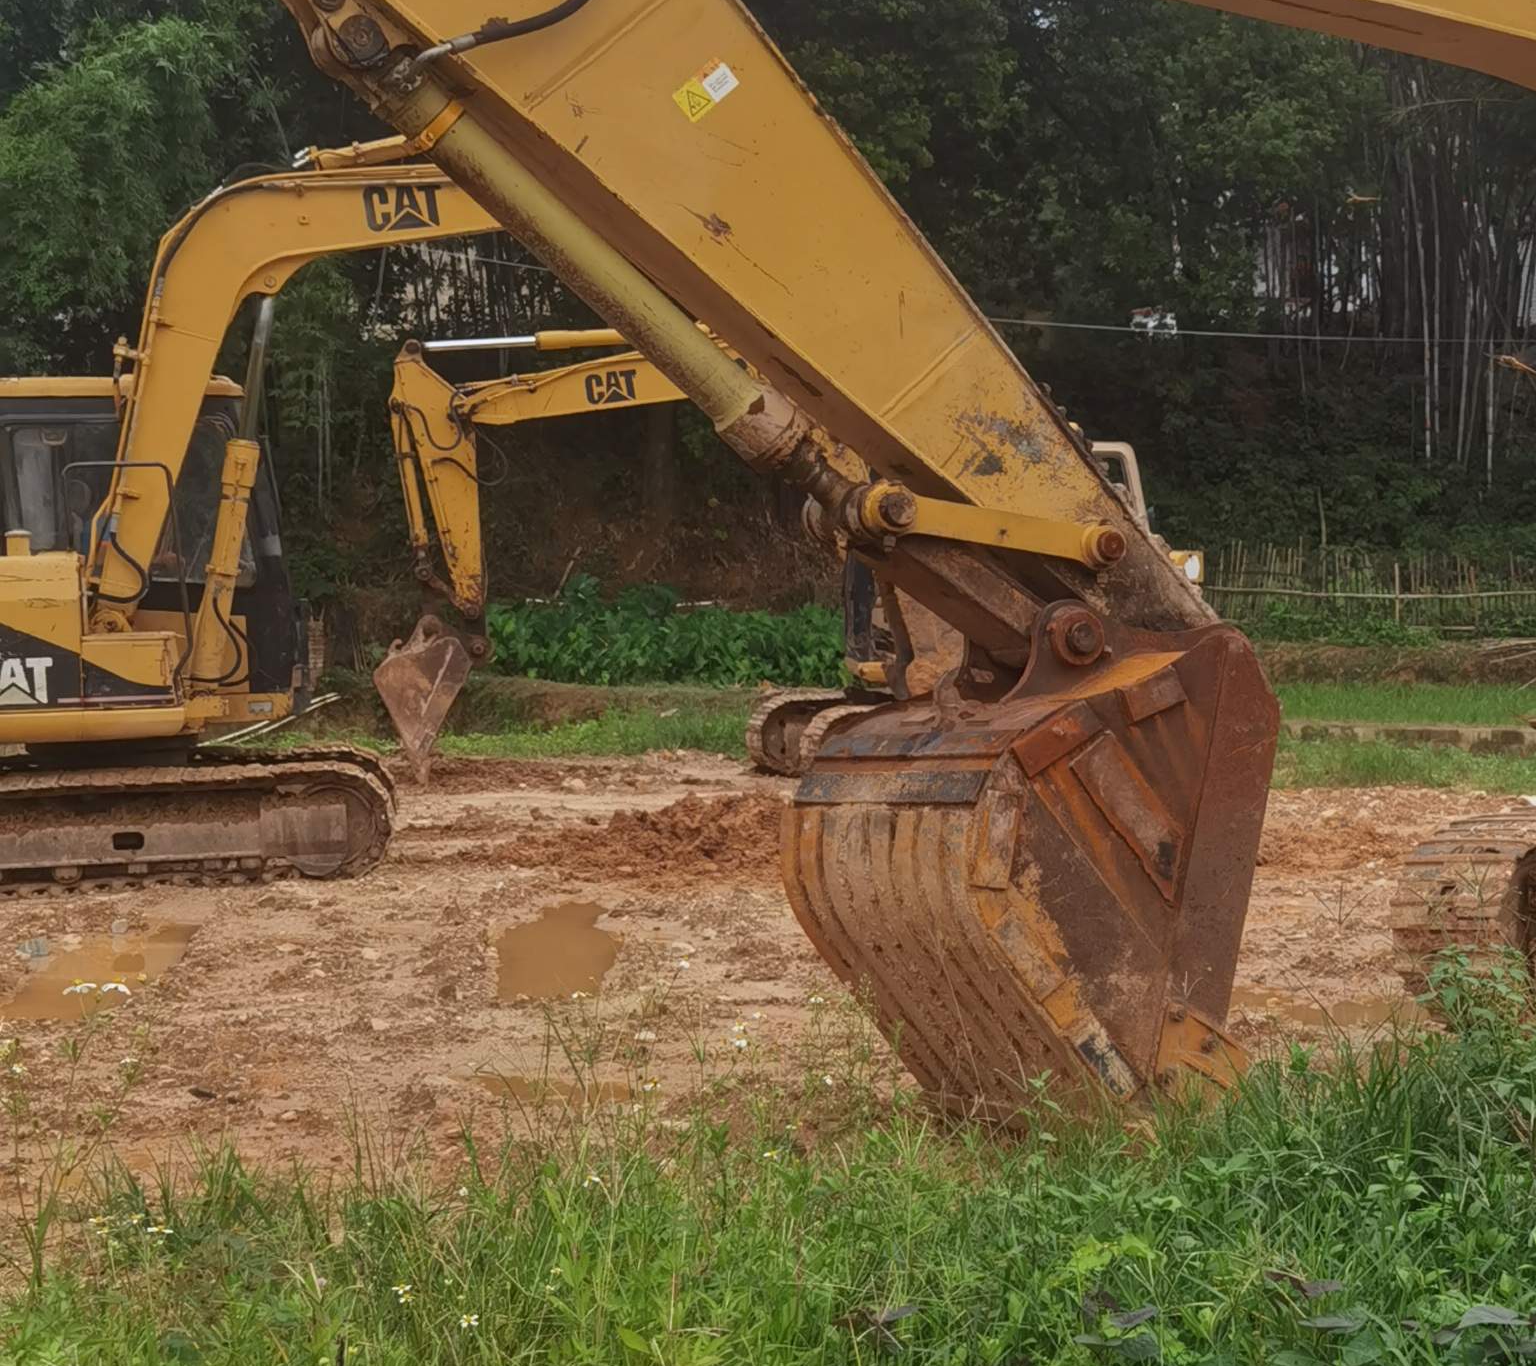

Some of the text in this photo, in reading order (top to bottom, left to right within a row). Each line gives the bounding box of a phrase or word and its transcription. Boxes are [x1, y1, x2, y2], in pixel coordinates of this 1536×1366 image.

[363, 185, 441, 232] CAT
[585, 369, 636, 404] CAT
[0, 657, 53, 704] AT
